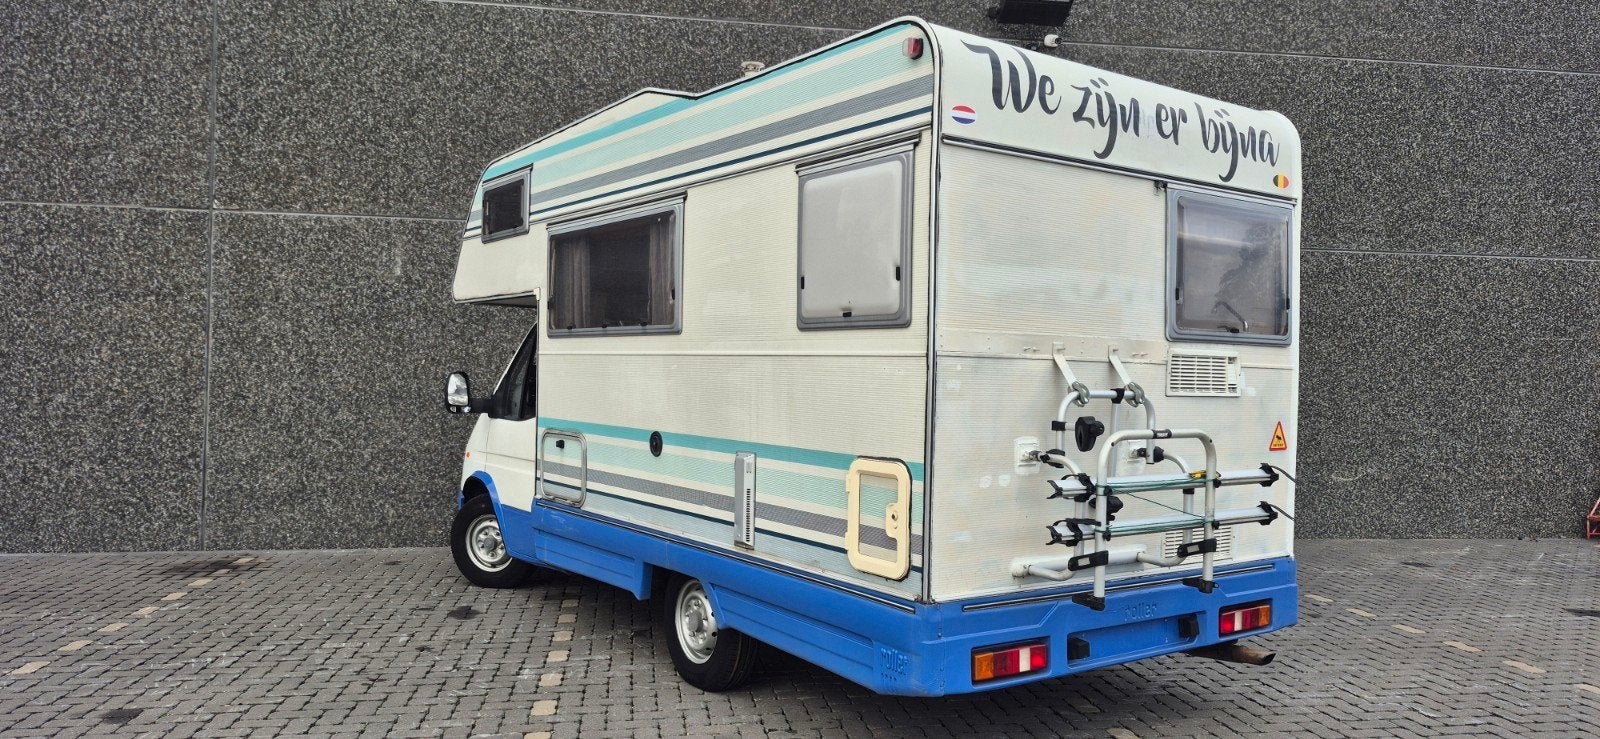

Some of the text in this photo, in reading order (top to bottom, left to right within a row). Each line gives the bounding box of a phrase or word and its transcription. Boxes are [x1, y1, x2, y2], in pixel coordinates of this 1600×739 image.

[960, 38, 1281, 183] We zijn er bijna
